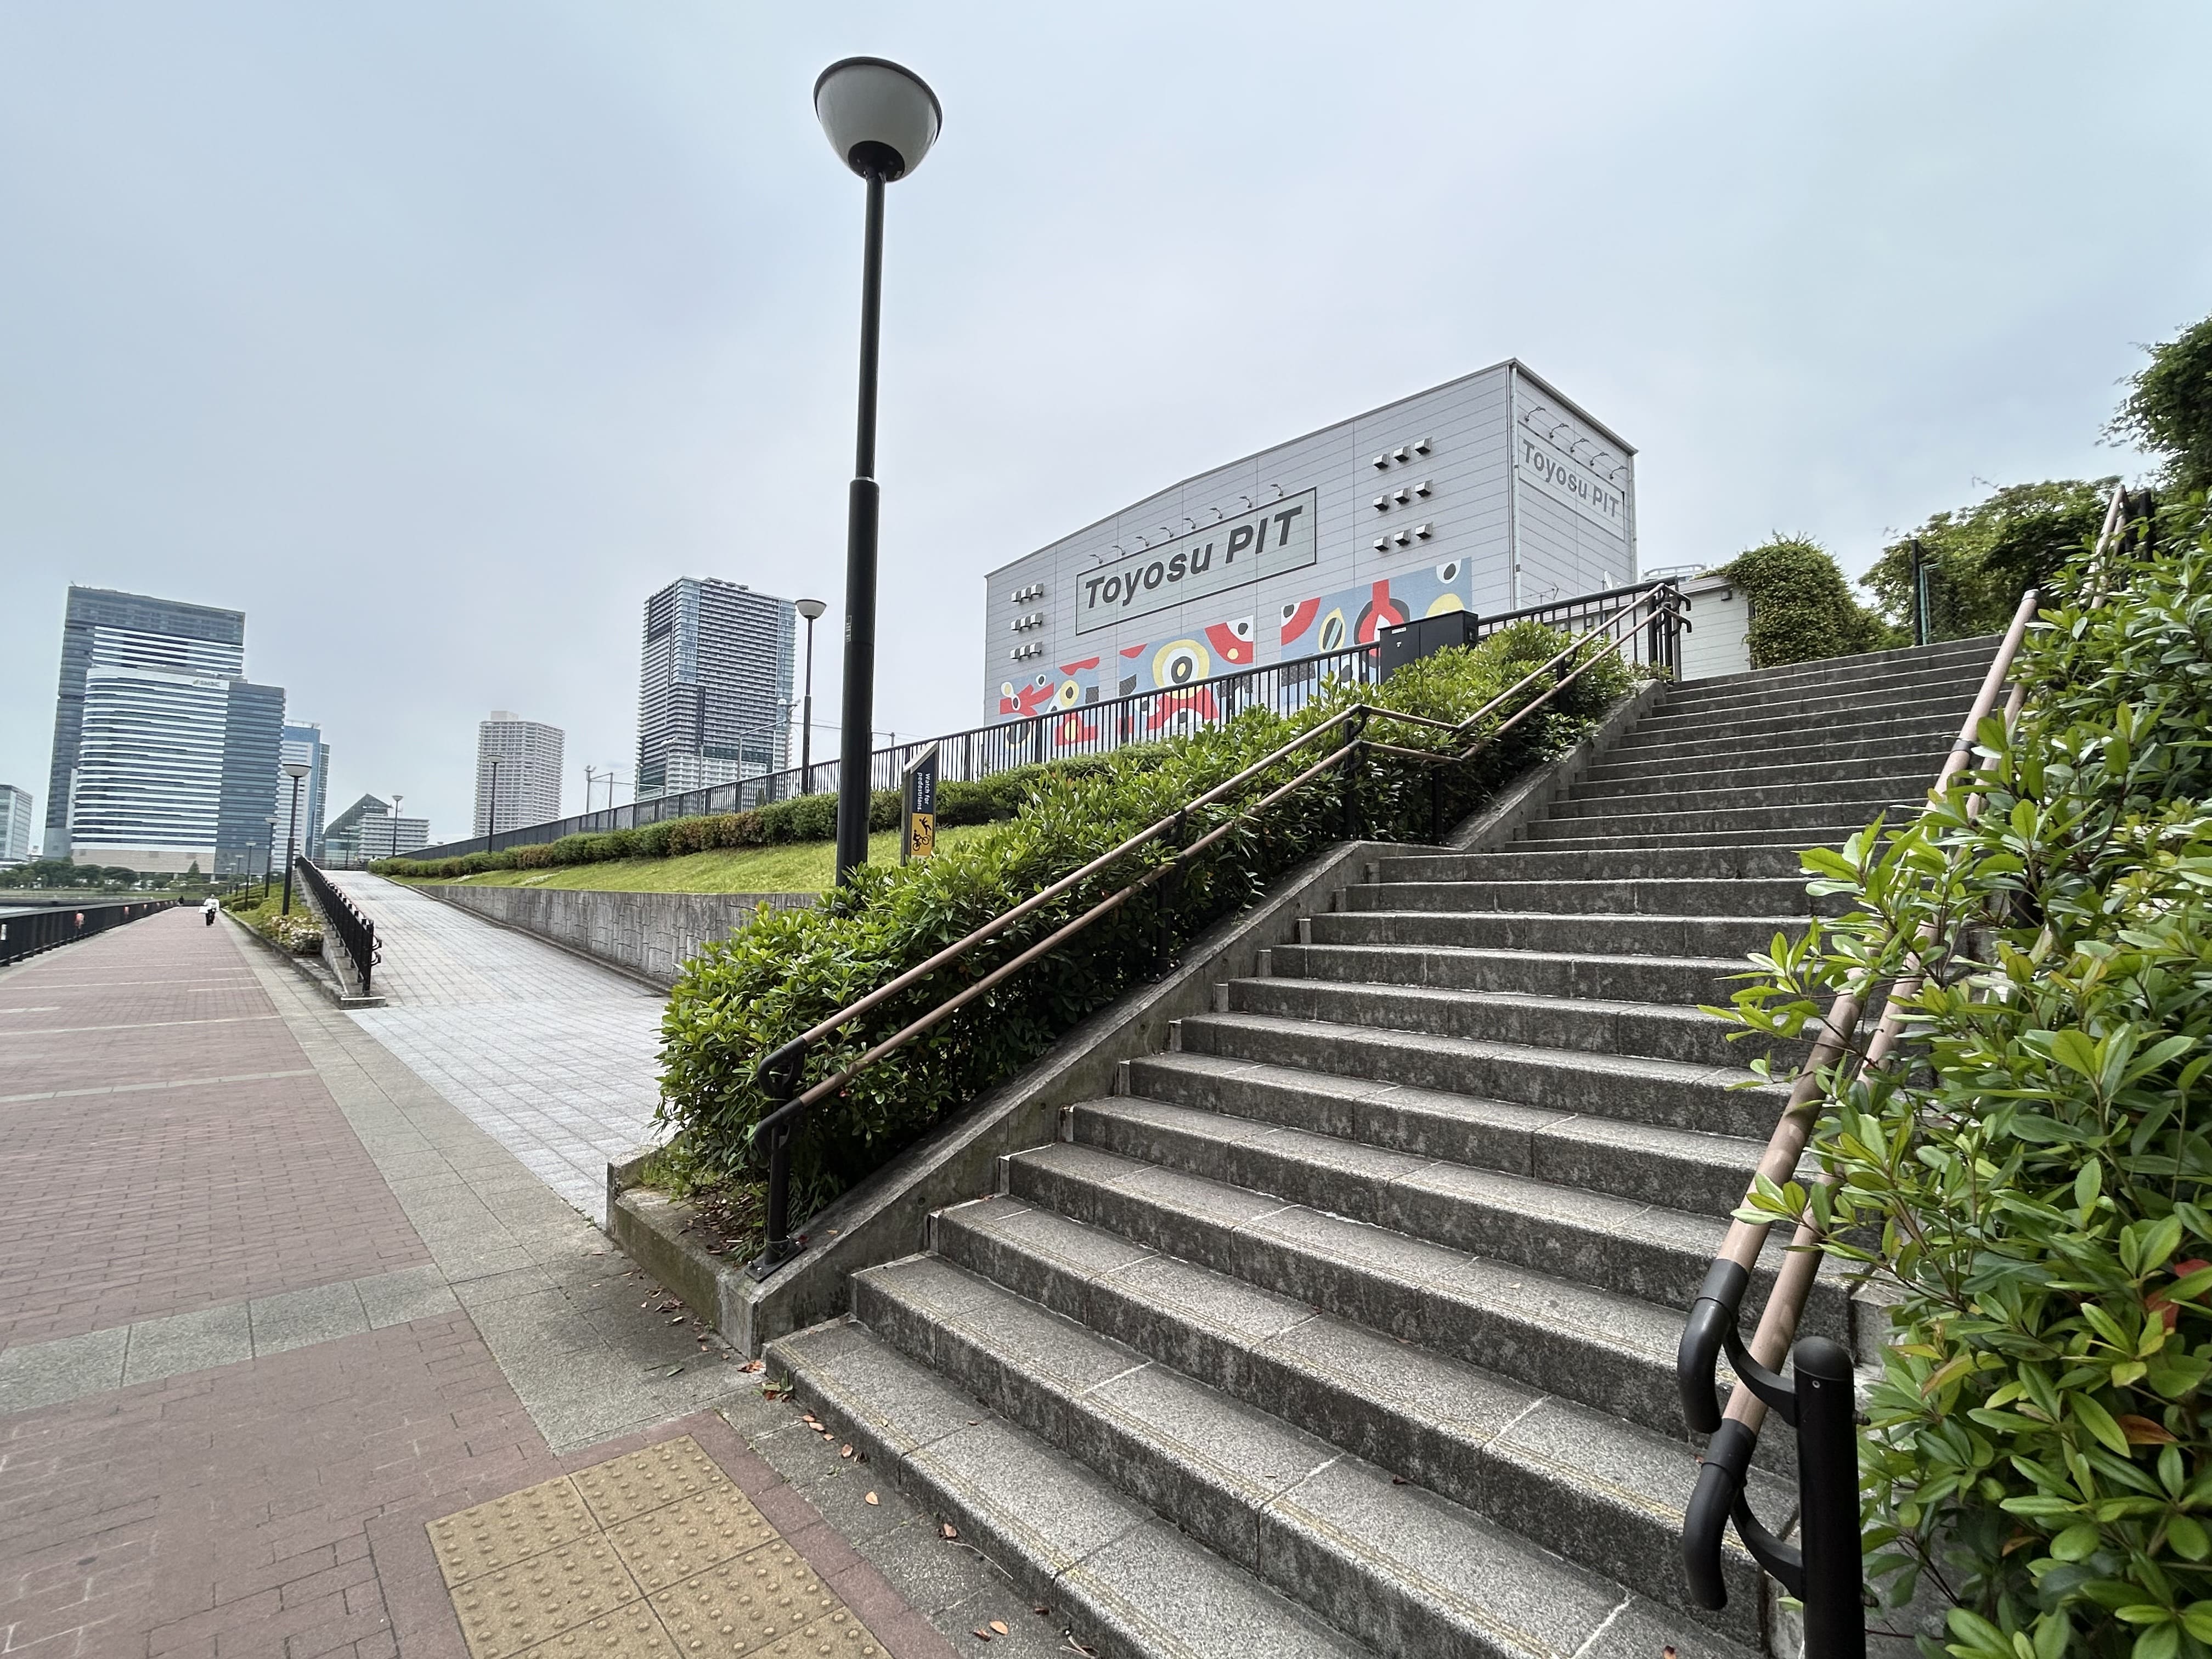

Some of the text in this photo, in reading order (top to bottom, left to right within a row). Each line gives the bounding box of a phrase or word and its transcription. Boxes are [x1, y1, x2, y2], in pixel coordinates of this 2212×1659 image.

[1523, 439, 1618, 517] Toyosu PIT
[1085, 505, 1303, 608] Toyosu PIT
